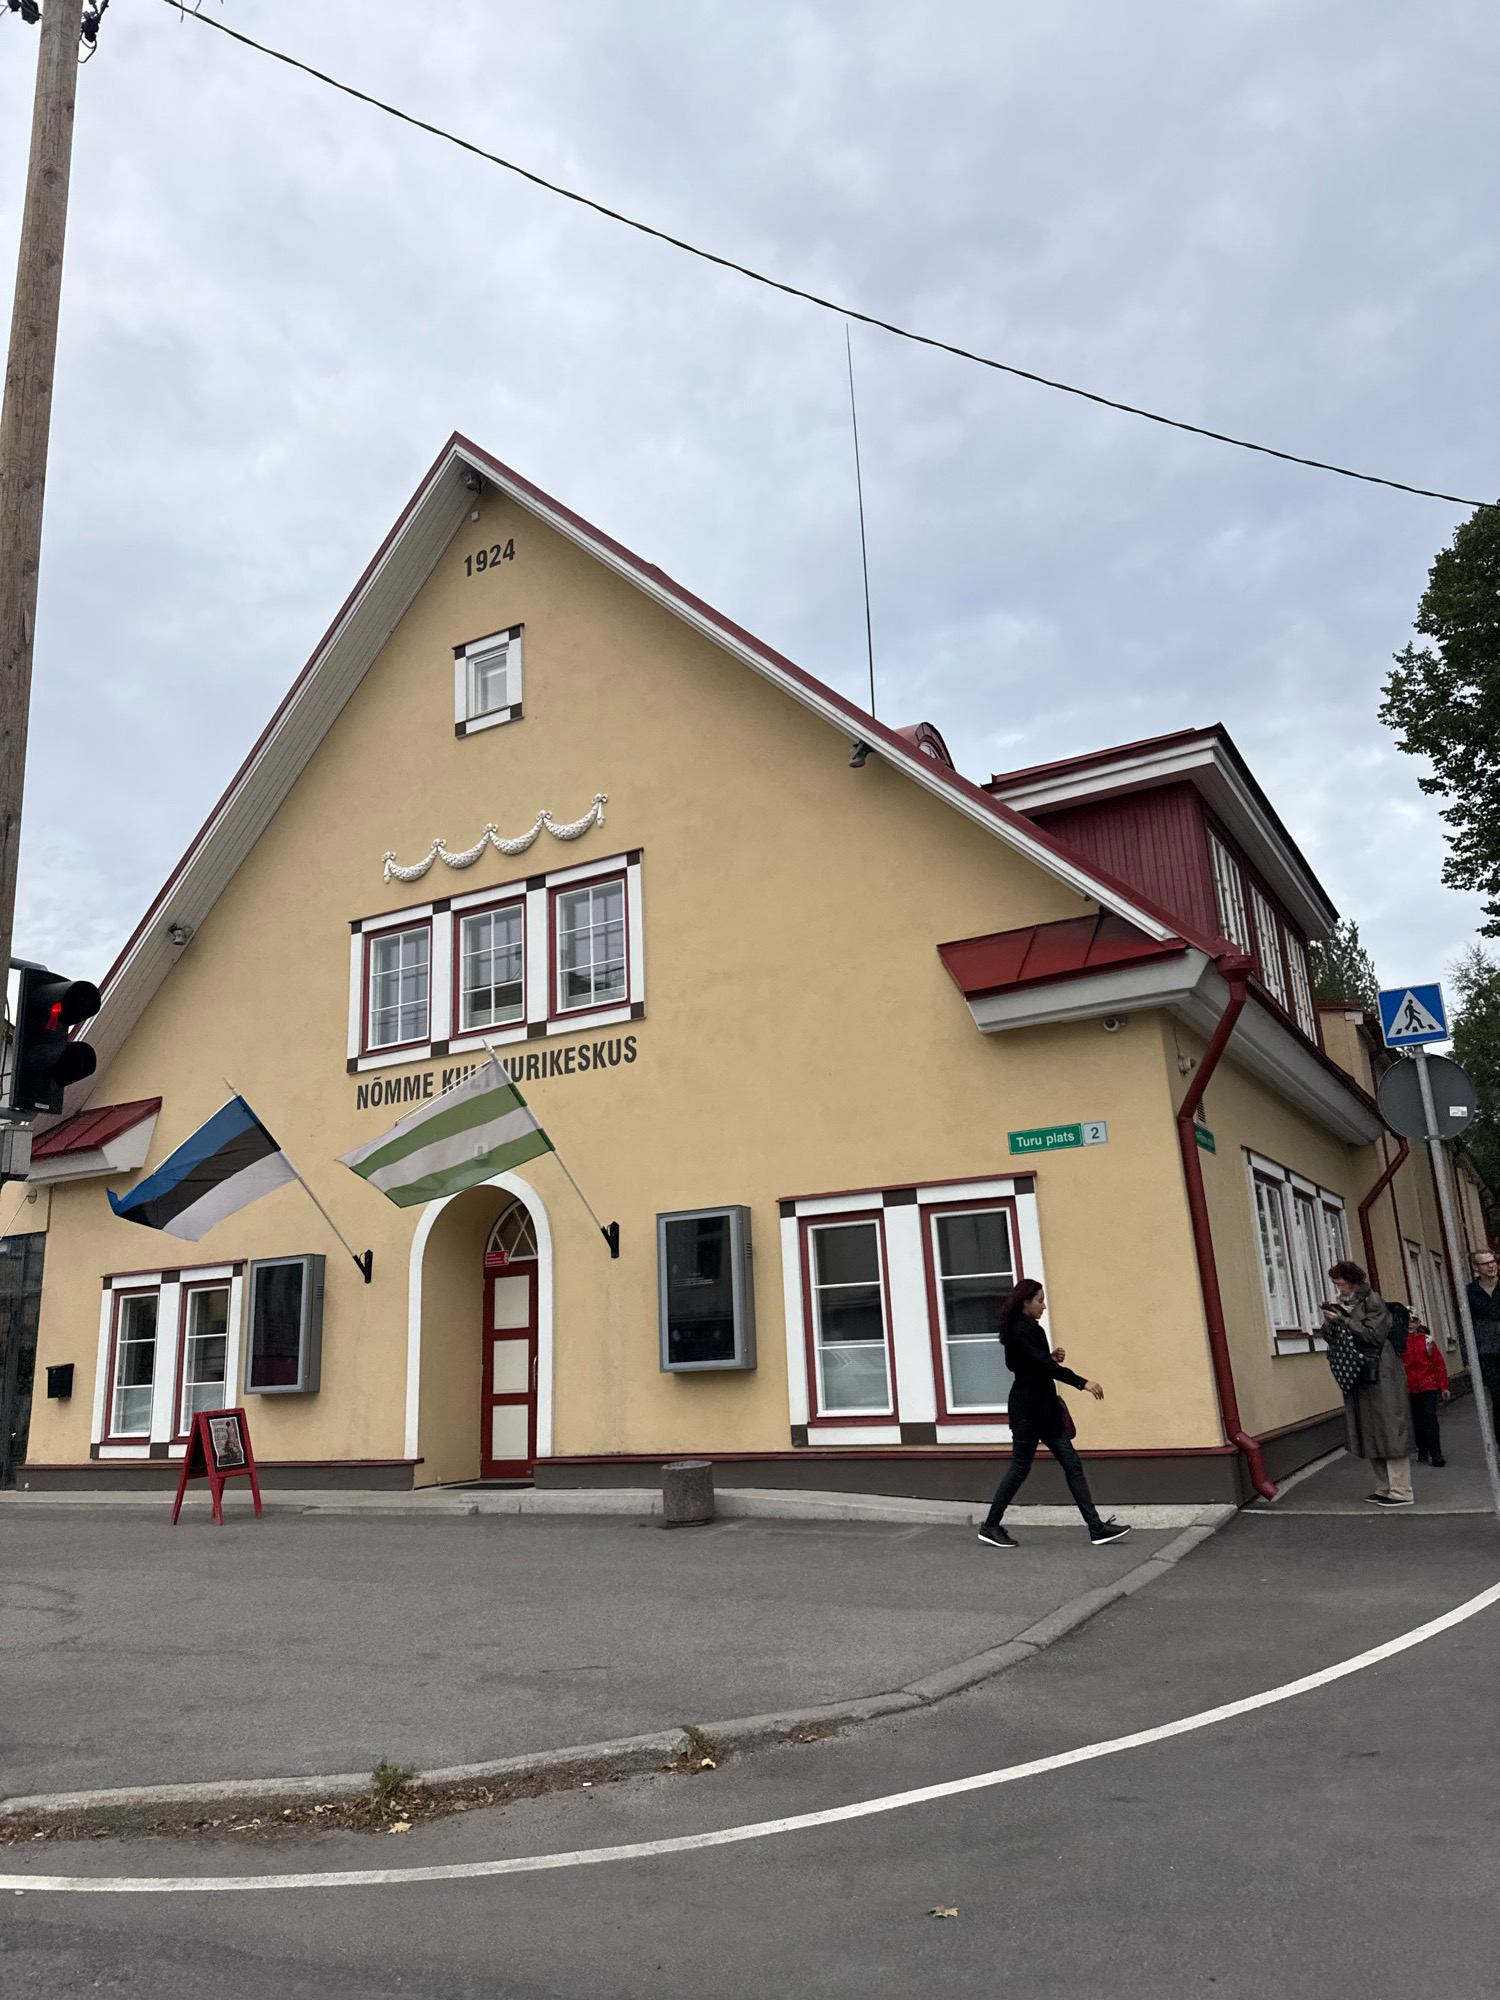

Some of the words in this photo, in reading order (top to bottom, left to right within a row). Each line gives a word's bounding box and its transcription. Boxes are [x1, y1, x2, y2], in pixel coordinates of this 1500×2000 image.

[464, 538, 516, 577] 1924
[356, 1071, 434, 1110] NÕMME
[442, 1036, 637, 1095] KULURIKESKUS
[1016, 1136, 1042, 1147] Turu
[1046, 1131, 1075, 1147] plats
[1090, 1126, 1100, 1140] 2
